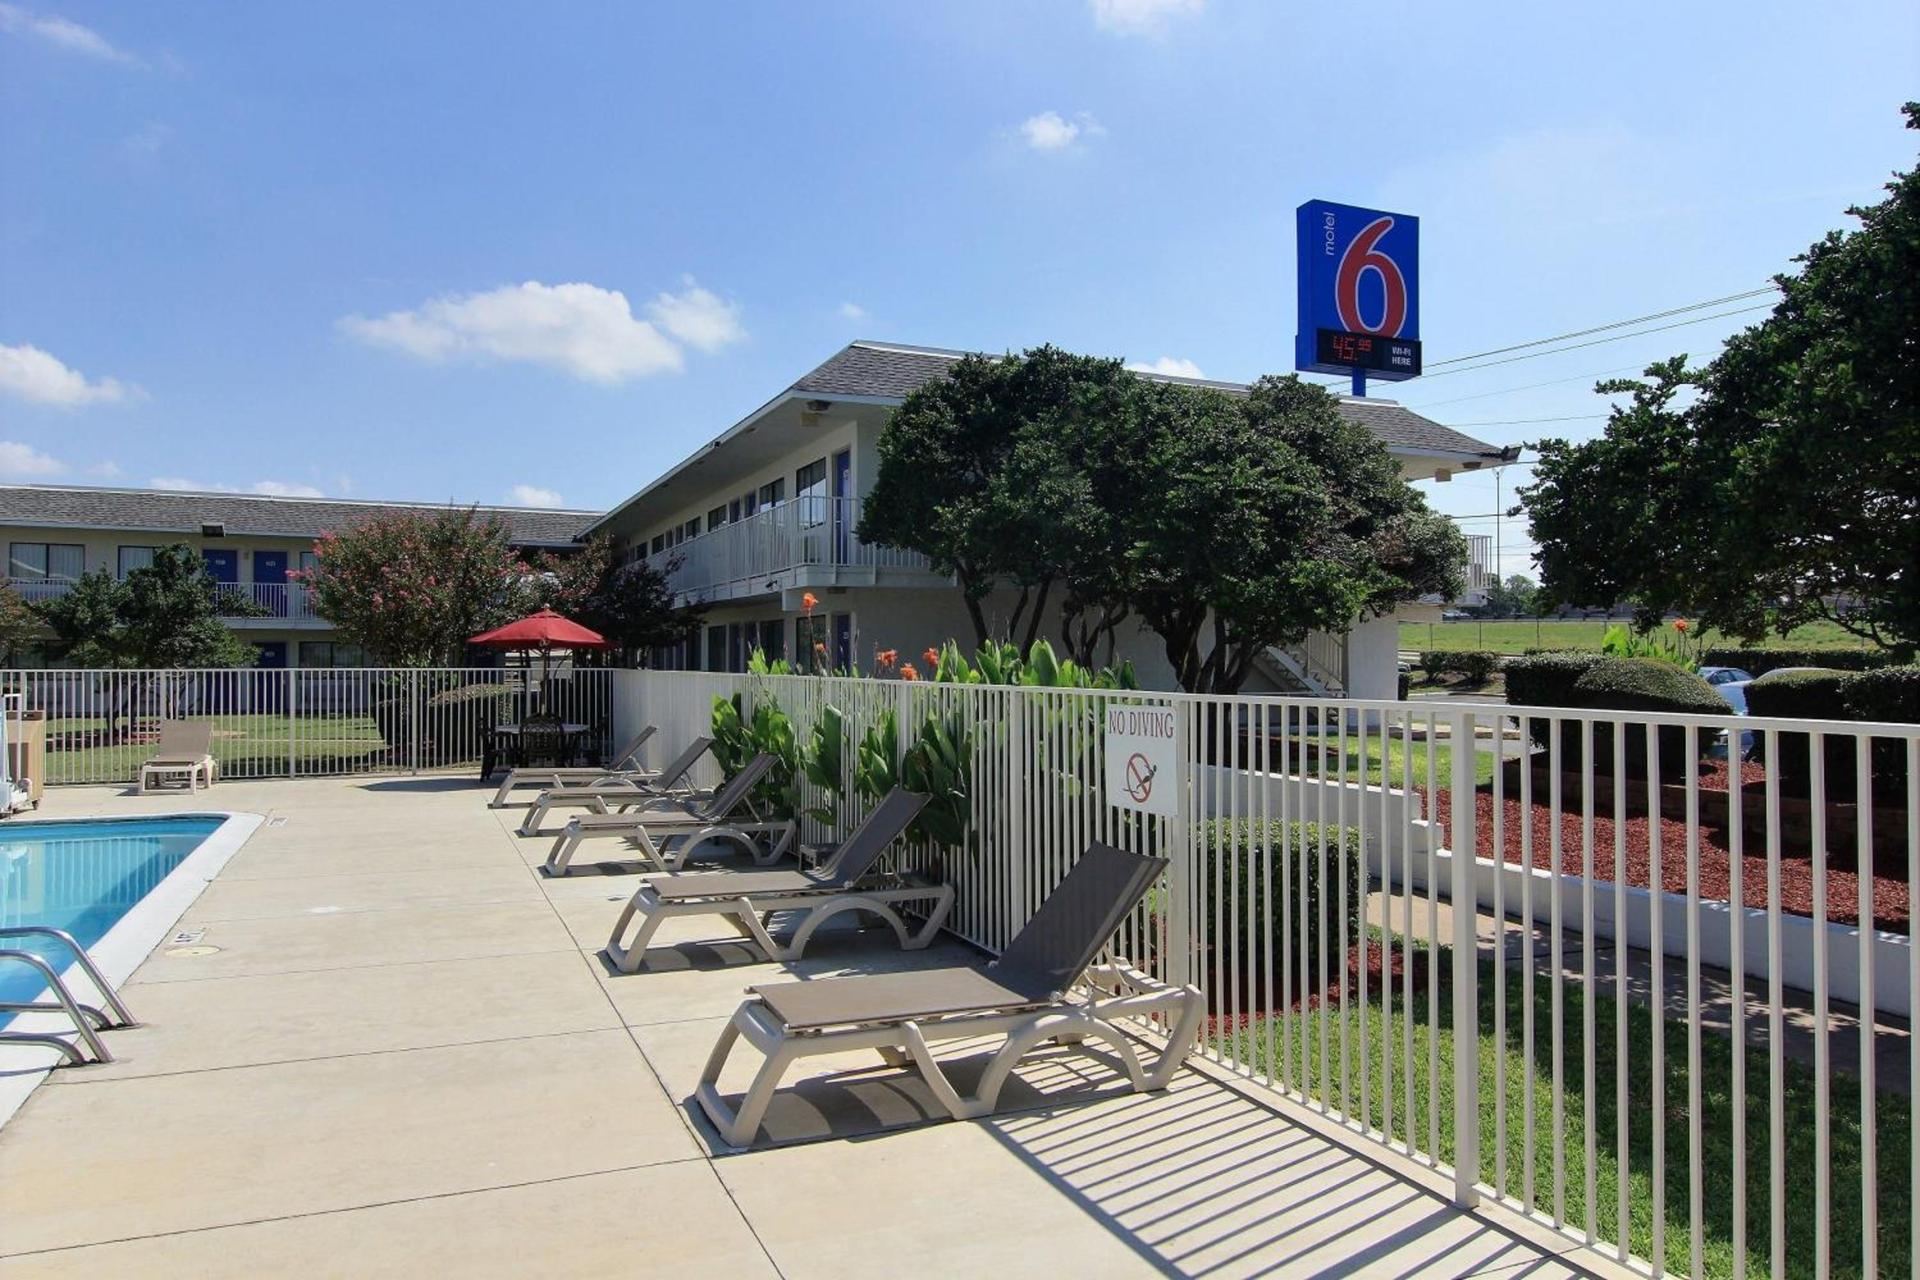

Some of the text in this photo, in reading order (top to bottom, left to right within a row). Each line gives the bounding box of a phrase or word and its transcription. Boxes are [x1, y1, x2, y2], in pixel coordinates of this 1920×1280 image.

[1323, 212, 1407, 338] motel 6
[1391, 356, 1412, 366] HERE
[1109, 710, 1174, 738] NO DIVING
